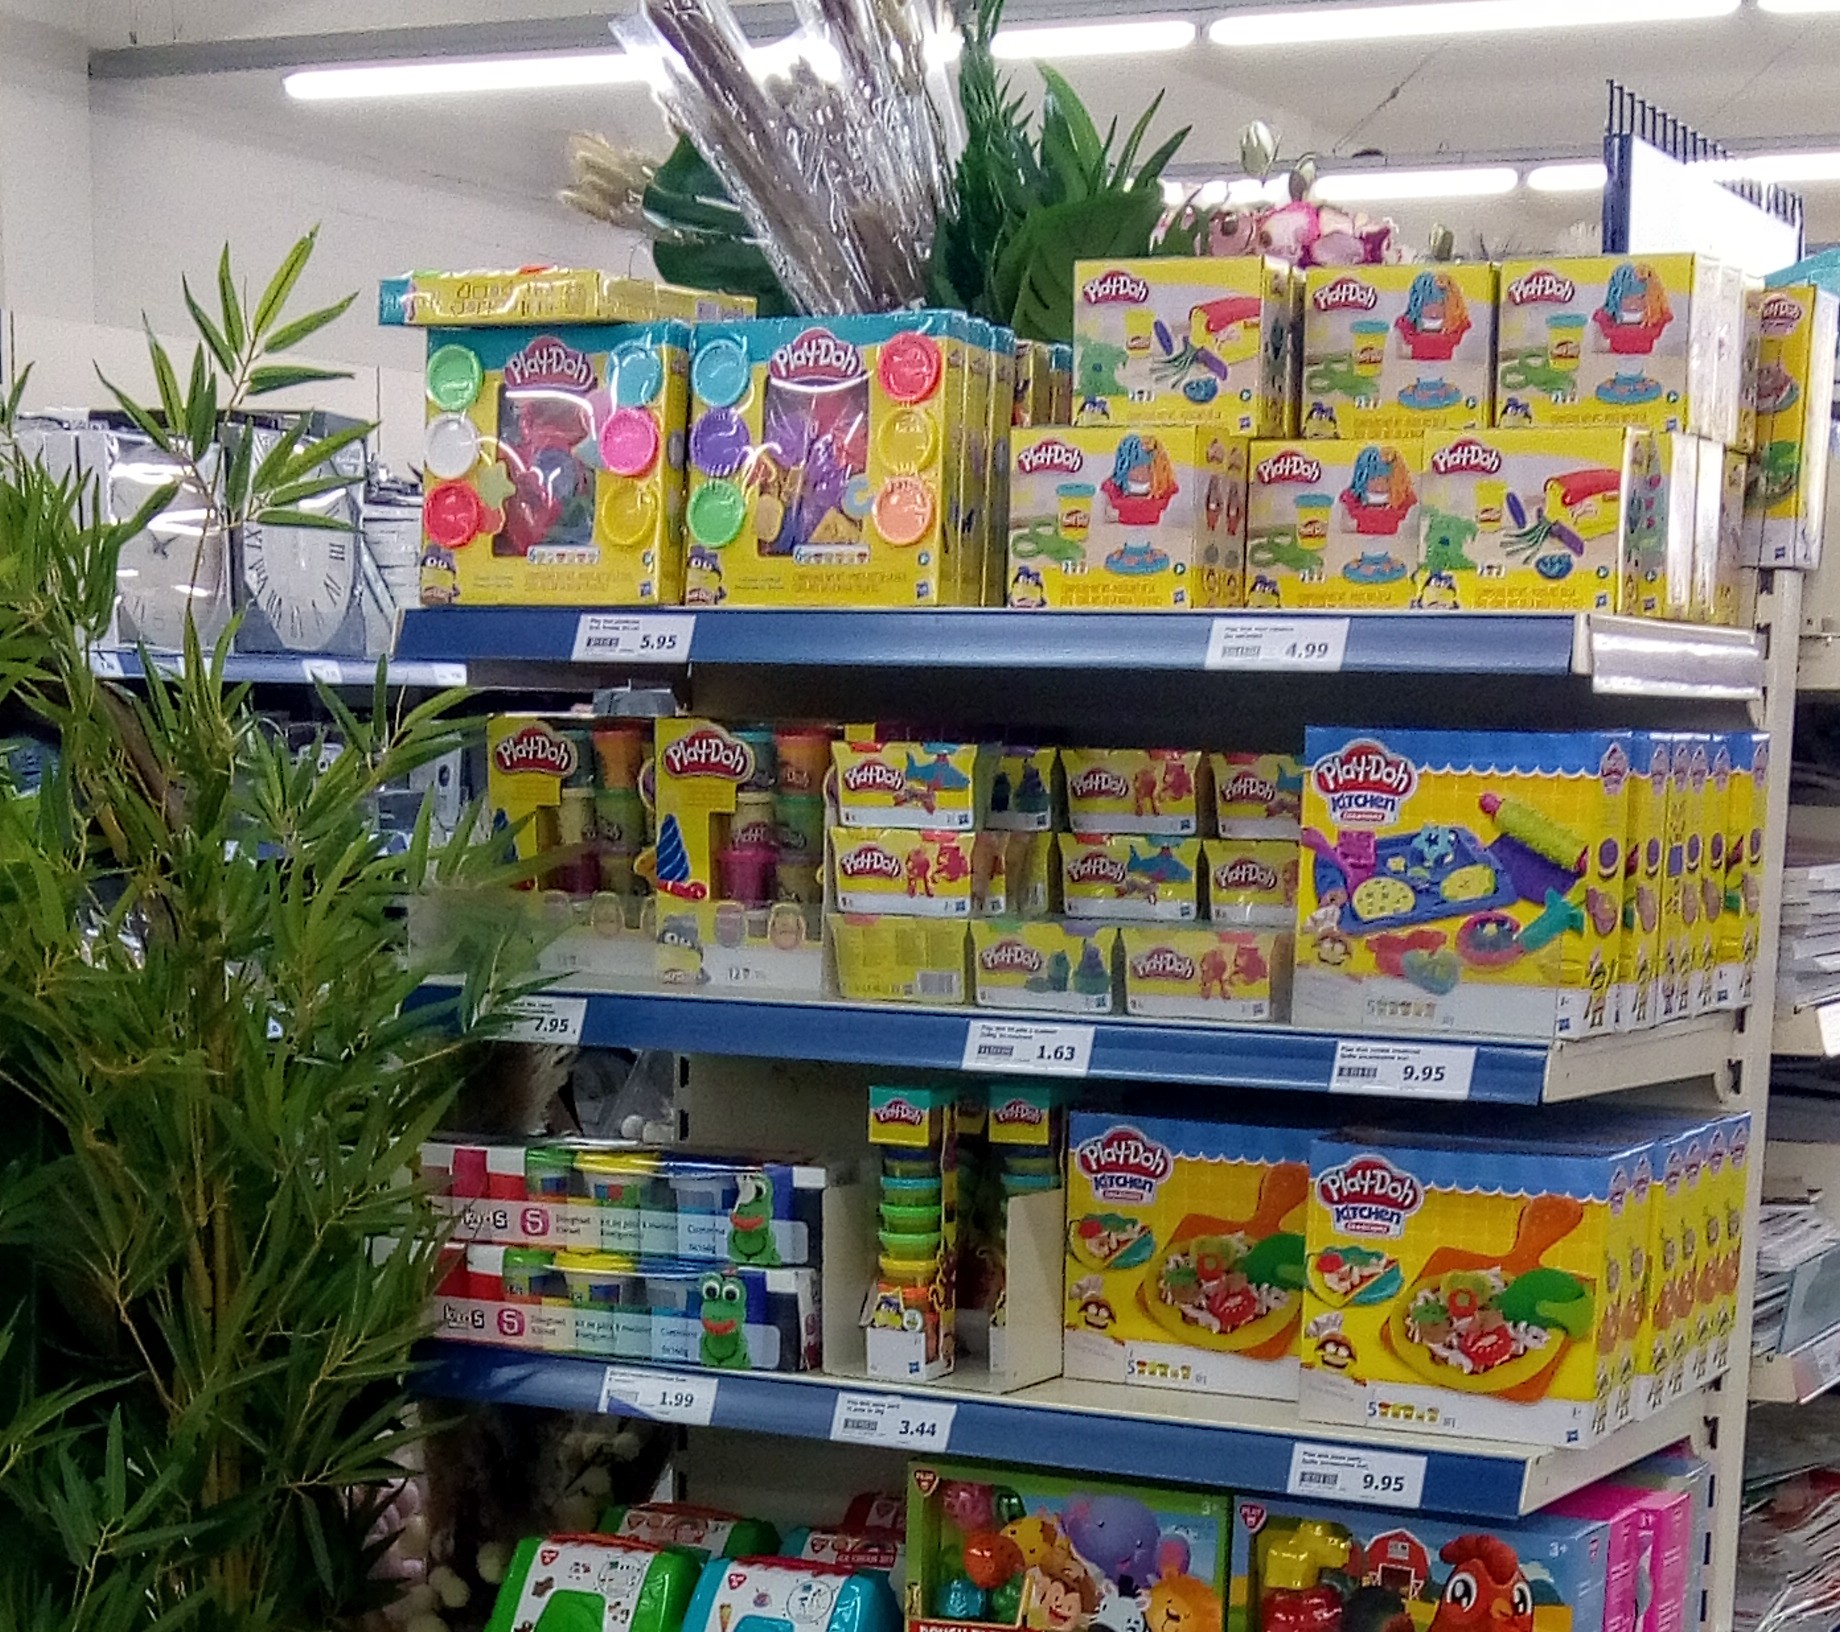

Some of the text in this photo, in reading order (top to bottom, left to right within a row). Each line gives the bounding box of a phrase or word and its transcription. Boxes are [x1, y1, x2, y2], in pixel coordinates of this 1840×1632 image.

[1083, 275, 1147, 303] Play-Doh
[1314, 281, 1378, 309] Play-Doh
[1509, 274, 1574, 303] Play-Doh
[511, 343, 588, 385] Play-Doh
[775, 335, 858, 373] Play-Doh
[1018, 444, 1082, 471] Play-Doh
[1258, 454, 1322, 482] Play-Doh
[1433, 446, 1500, 474] Play-Doh
[640, 633, 677, 651] 5.95
[1285, 641, 1330, 659] 4.99
[497, 737, 569, 775] Play-Doh
[665, 739, 745, 774] Play-Doh
[844, 762, 904, 791] Play-Doh
[1070, 770, 1130, 799] Play-Doh
[1221, 775, 1277, 801] Play-Doh
[1318, 756, 1410, 794] Play-Doh
[840, 848, 900, 879] Play-Doh
[1066, 858, 1127, 885] Play-Doh
[1214, 863, 1277, 890] Play-Doh
[981, 946, 1043, 972] Play-Doh
[1133, 953, 1195, 981] Play-Doh
[533, 1017, 569, 1033] 7.95
[1036, 1044, 1076, 1062] 1.63
[1402, 1065, 1446, 1083] 9.95
[874, 1104, 923, 1126] Play-Doh
[993, 1104, 1045, 1126] Play-Doh
[1083, 1137, 1168, 1175] Play-Doh
[1322, 1167, 1416, 1207] Play-Doh
[659, 1390, 696, 1408] 1.99
[898, 1419, 938, 1438] 3.44
[1361, 1473, 1405, 1493] 9.95
[1549, 1541, 1569, 1558] 3+
